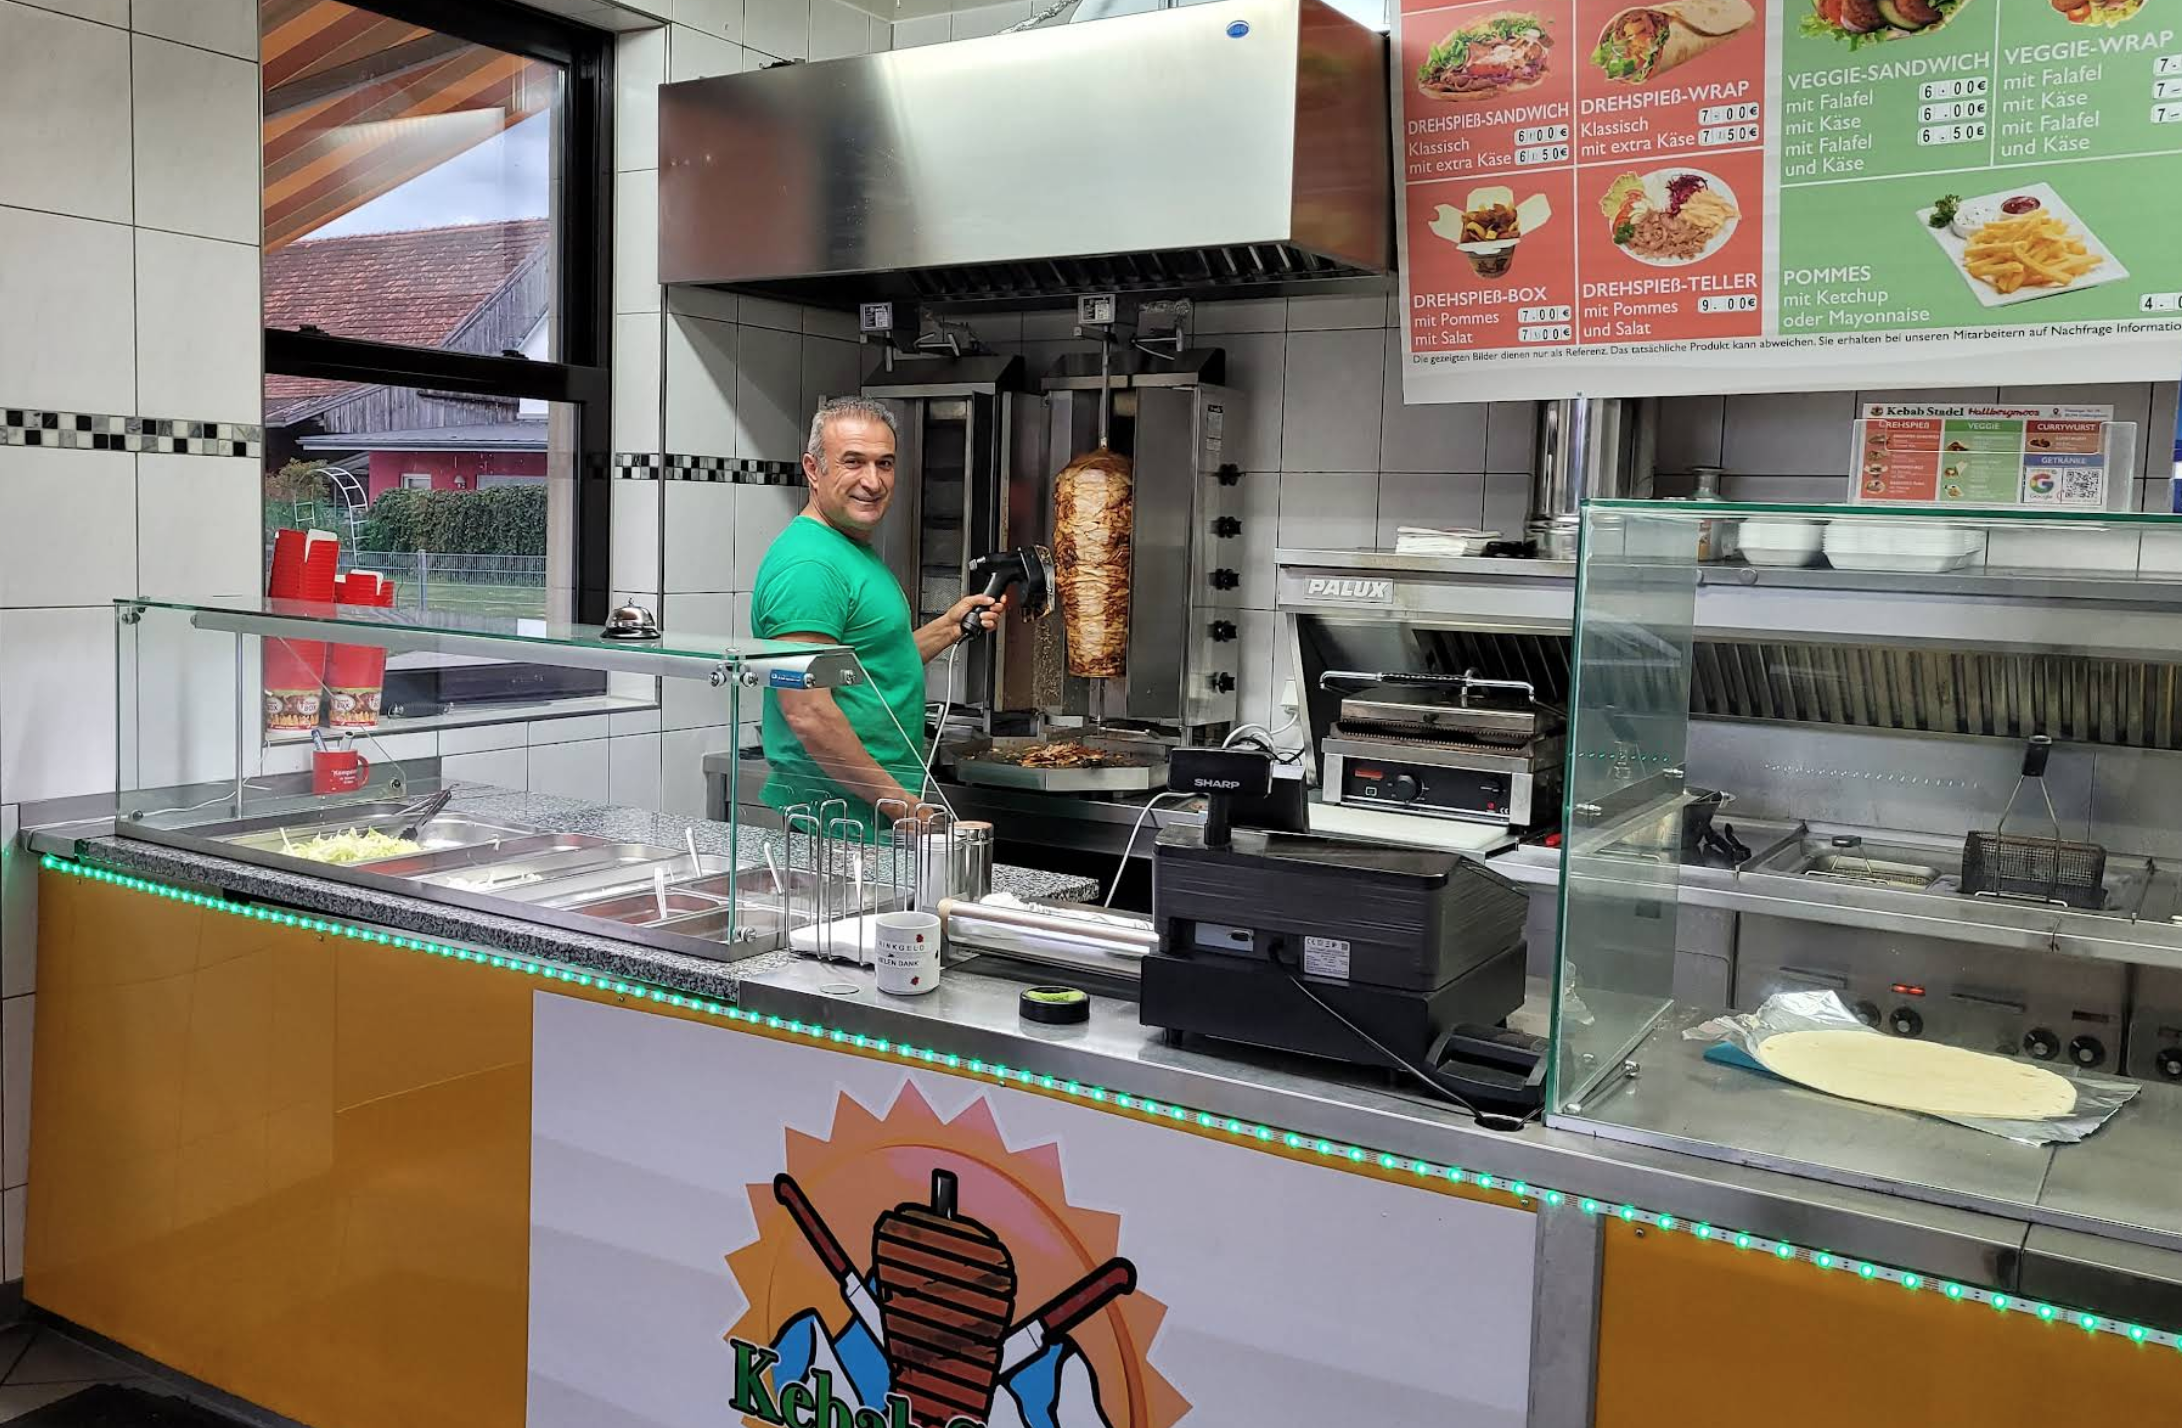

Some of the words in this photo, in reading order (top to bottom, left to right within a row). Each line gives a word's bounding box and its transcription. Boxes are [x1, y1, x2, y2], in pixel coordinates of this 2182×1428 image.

[2004, 30, 2174, 65] VEGGIE-WRAP
[1788, 52, 1990, 90] VEGGIE-SANDWICH
[2003, 73, 2036, 91] mit
[2042, 63, 2102, 86] Falafel
[1786, 100, 1814, 114] mit
[1820, 89, 1873, 110] Falafel
[2003, 97, 2034, 113] mit
[2041, 91, 2088, 109] Käse
[1581, 117, 1649, 138] Klassisch
[1786, 122, 1814, 136] mit
[1820, 115, 1861, 132] Käse
[2002, 119, 2033, 135] mit
[2040, 110, 2100, 132] Falafel
[1409, 137, 1469, 157] Klassisch
[1581, 142, 1607, 156] mit
[1611, 138, 1652, 153] extra
[1657, 131, 1695, 149] Käse
[1786, 143, 1813, 157] mit
[1820, 133, 1873, 153] Falafel
[2001, 138, 2036, 157] und
[2044, 136, 2091, 153] Käse
[1409, 160, 1433, 174] mit
[1436, 157, 1473, 172] extra
[1477, 152, 1512, 168] Käse
[1786, 160, 1816, 176] und
[1823, 156, 1865, 173] Käse
[1783, 265, 1872, 286] POMMES
[1783, 292, 1811, 307] mit
[1816, 287, 1889, 307] Ketchup
[1414, 314, 1437, 328] mit
[1441, 312, 1500, 327] Pommes
[1584, 304, 1608, 318] mit
[1613, 301, 1678, 317] Pommes
[1783, 312, 1823, 328] oder
[1829, 307, 1931, 329] Mayonnaise
[1415, 333, 1438, 346] mit
[1441, 330, 1474, 345] Salat
[1583, 323, 1611, 337] und
[1616, 321, 1651, 335] Salat
[1412, 354, 1429, 364] Die
[1430, 353, 1470, 365] gezeigten
[1472, 351, 1498, 361] Bilder
[1501, 350, 1530, 360] dienen
[1533, 351, 1547, 359] nur
[1551, 347, 1563, 357] als
[1611, 345, 1629, 355] Das
[1690, 340, 1730, 352] Produkt
[1732, 339, 1756, 350] kann
[1759, 336, 1816, 349] abweichen.
[1819, 335, 1834, 346] Sie
[1837, 333, 1881, 345] erhalten
[1885, 331, 1902, 343] bei
[1905, 331, 1950, 342] unseren
[1953, 328, 2025, 341] Mitarbeitern
[2029, 326, 2048, 337] auf
[2051, 323, 2113, 337] Nachfrage
[1886, 406, 1924, 417] Kebab
[1926, 406, 1964, 417] Stadel
[1968, 421, 2001, 430] VEGGIE
[2037, 423, 2097, 432] CURRYWURST
[1308, 578, 1388, 599] PALUX
[1194, 778, 1240, 789] SHARP
